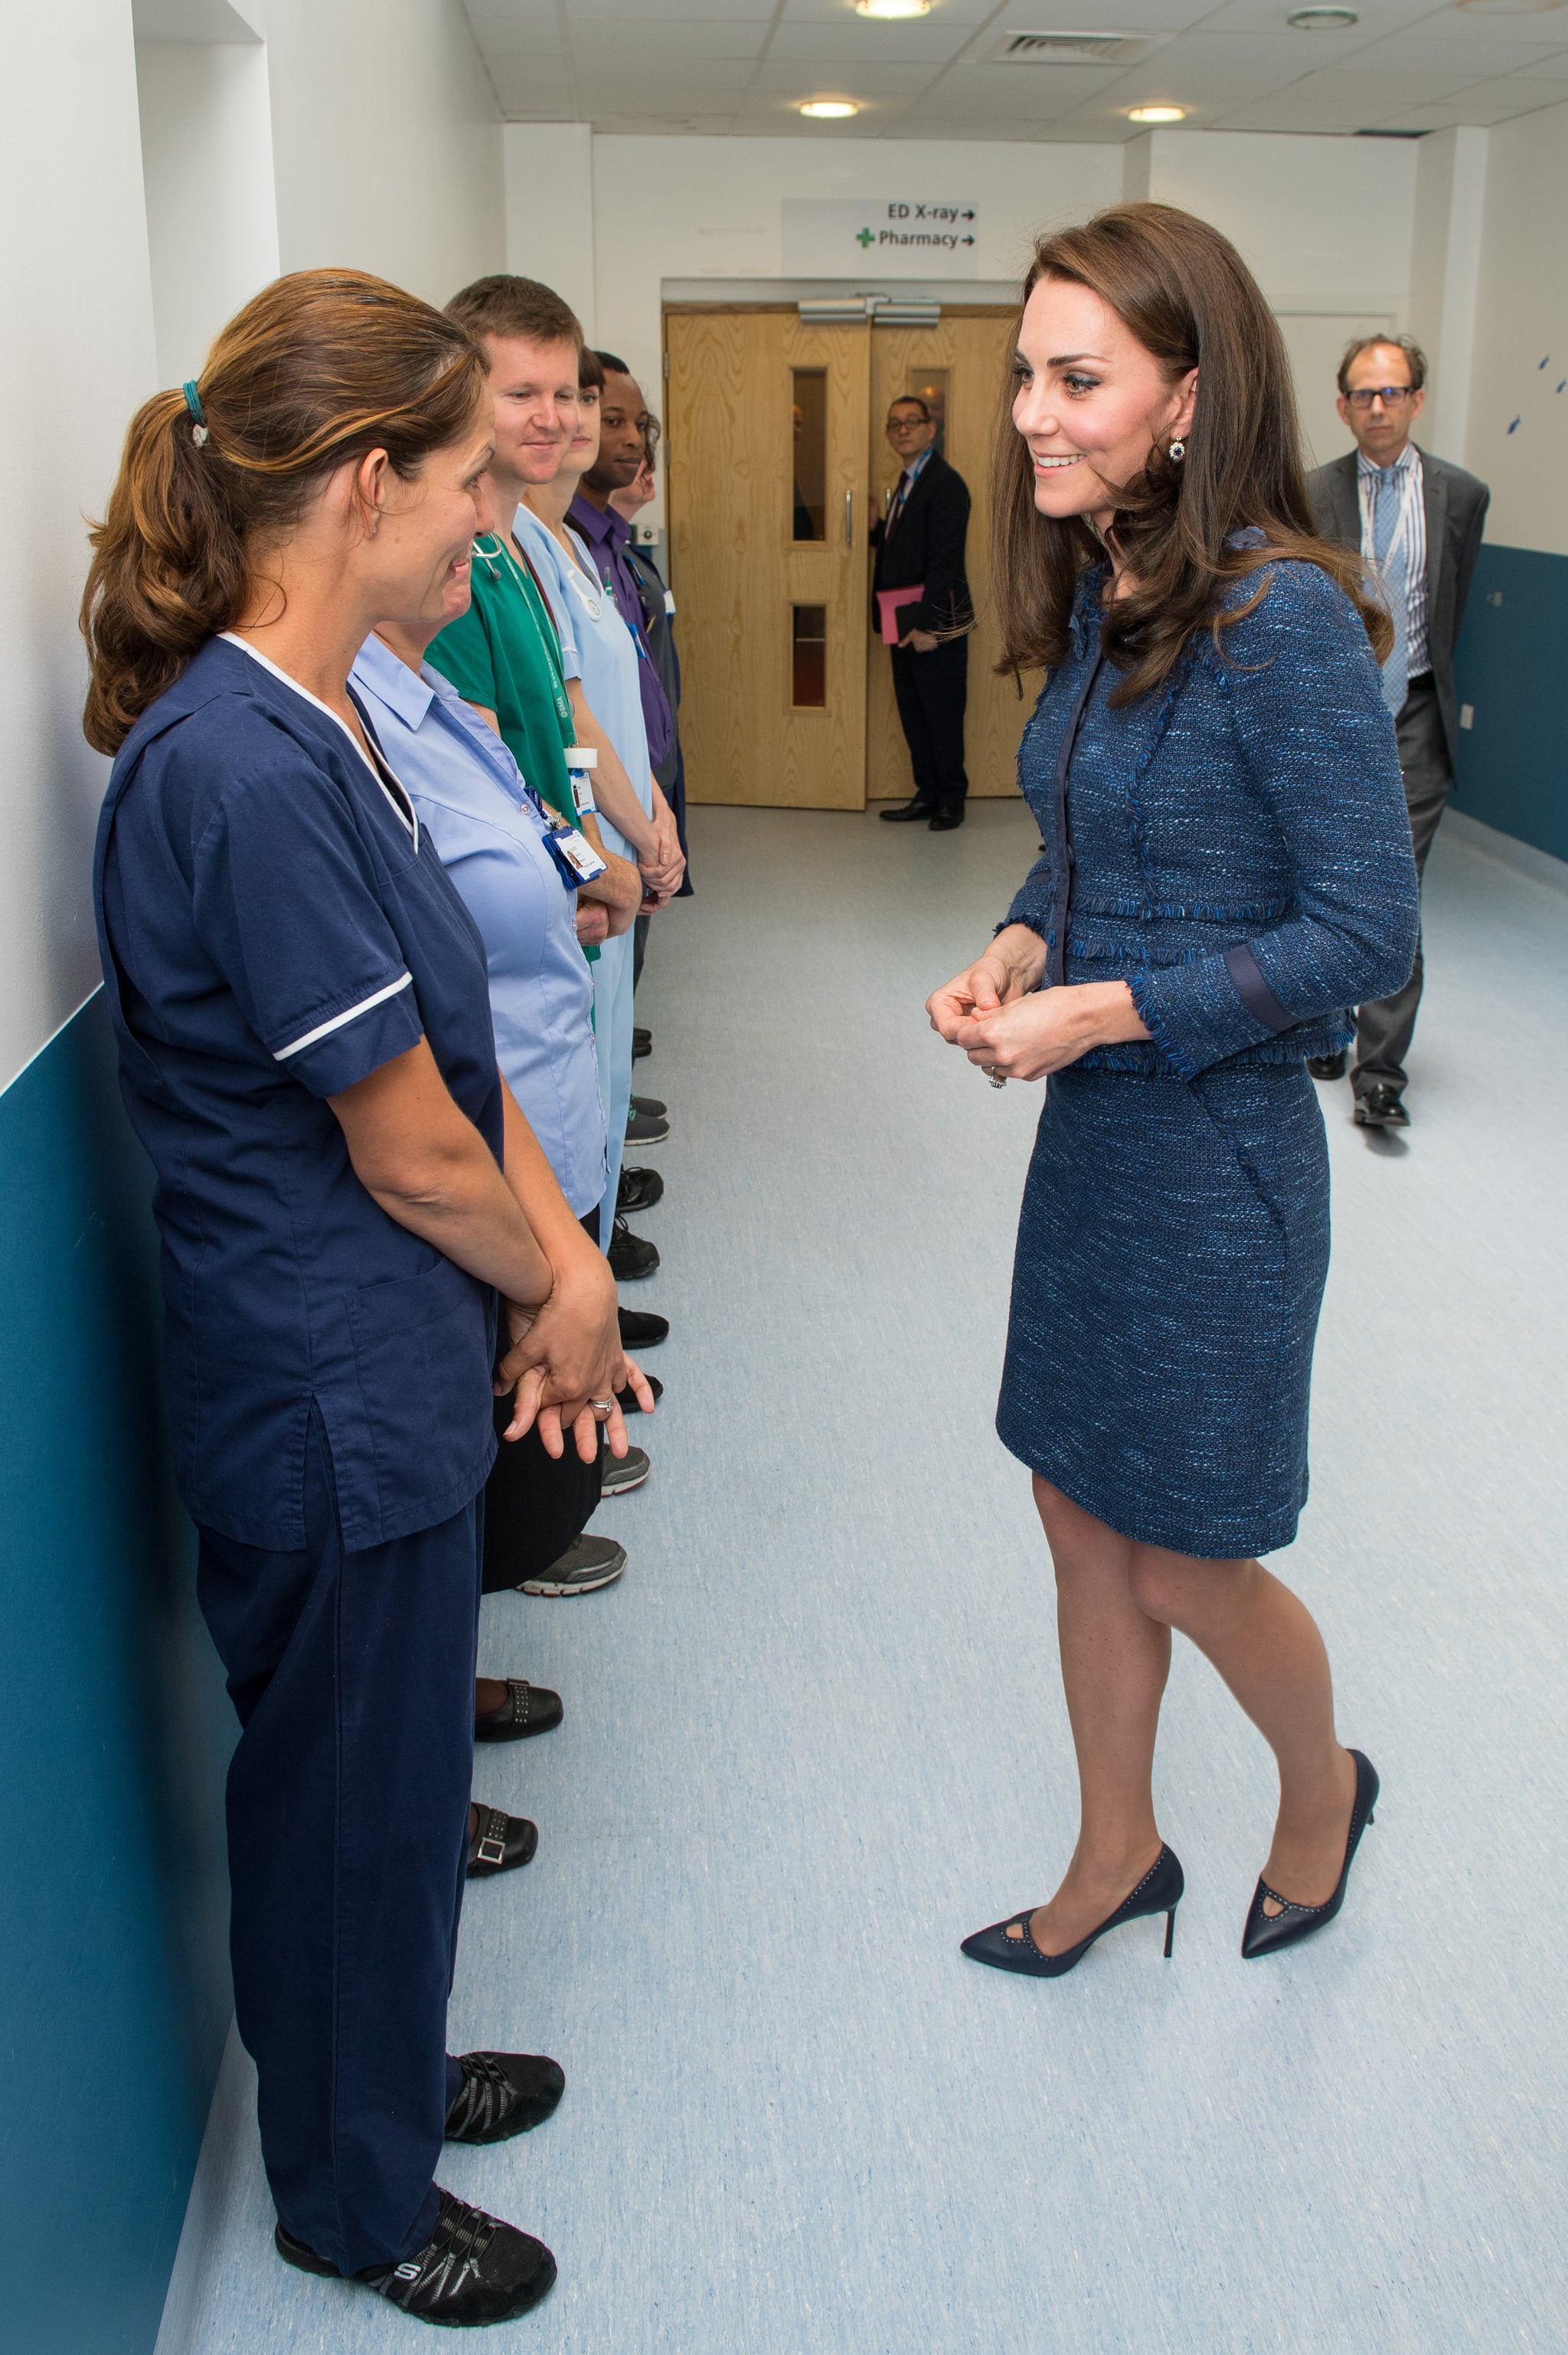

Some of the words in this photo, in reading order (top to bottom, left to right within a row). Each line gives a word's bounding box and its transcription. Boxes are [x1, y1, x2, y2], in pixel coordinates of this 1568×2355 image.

[887, 204, 910, 218] ED
[915, 204, 959, 223] X-ray
[879, 231, 959, 249] Pharmacy
